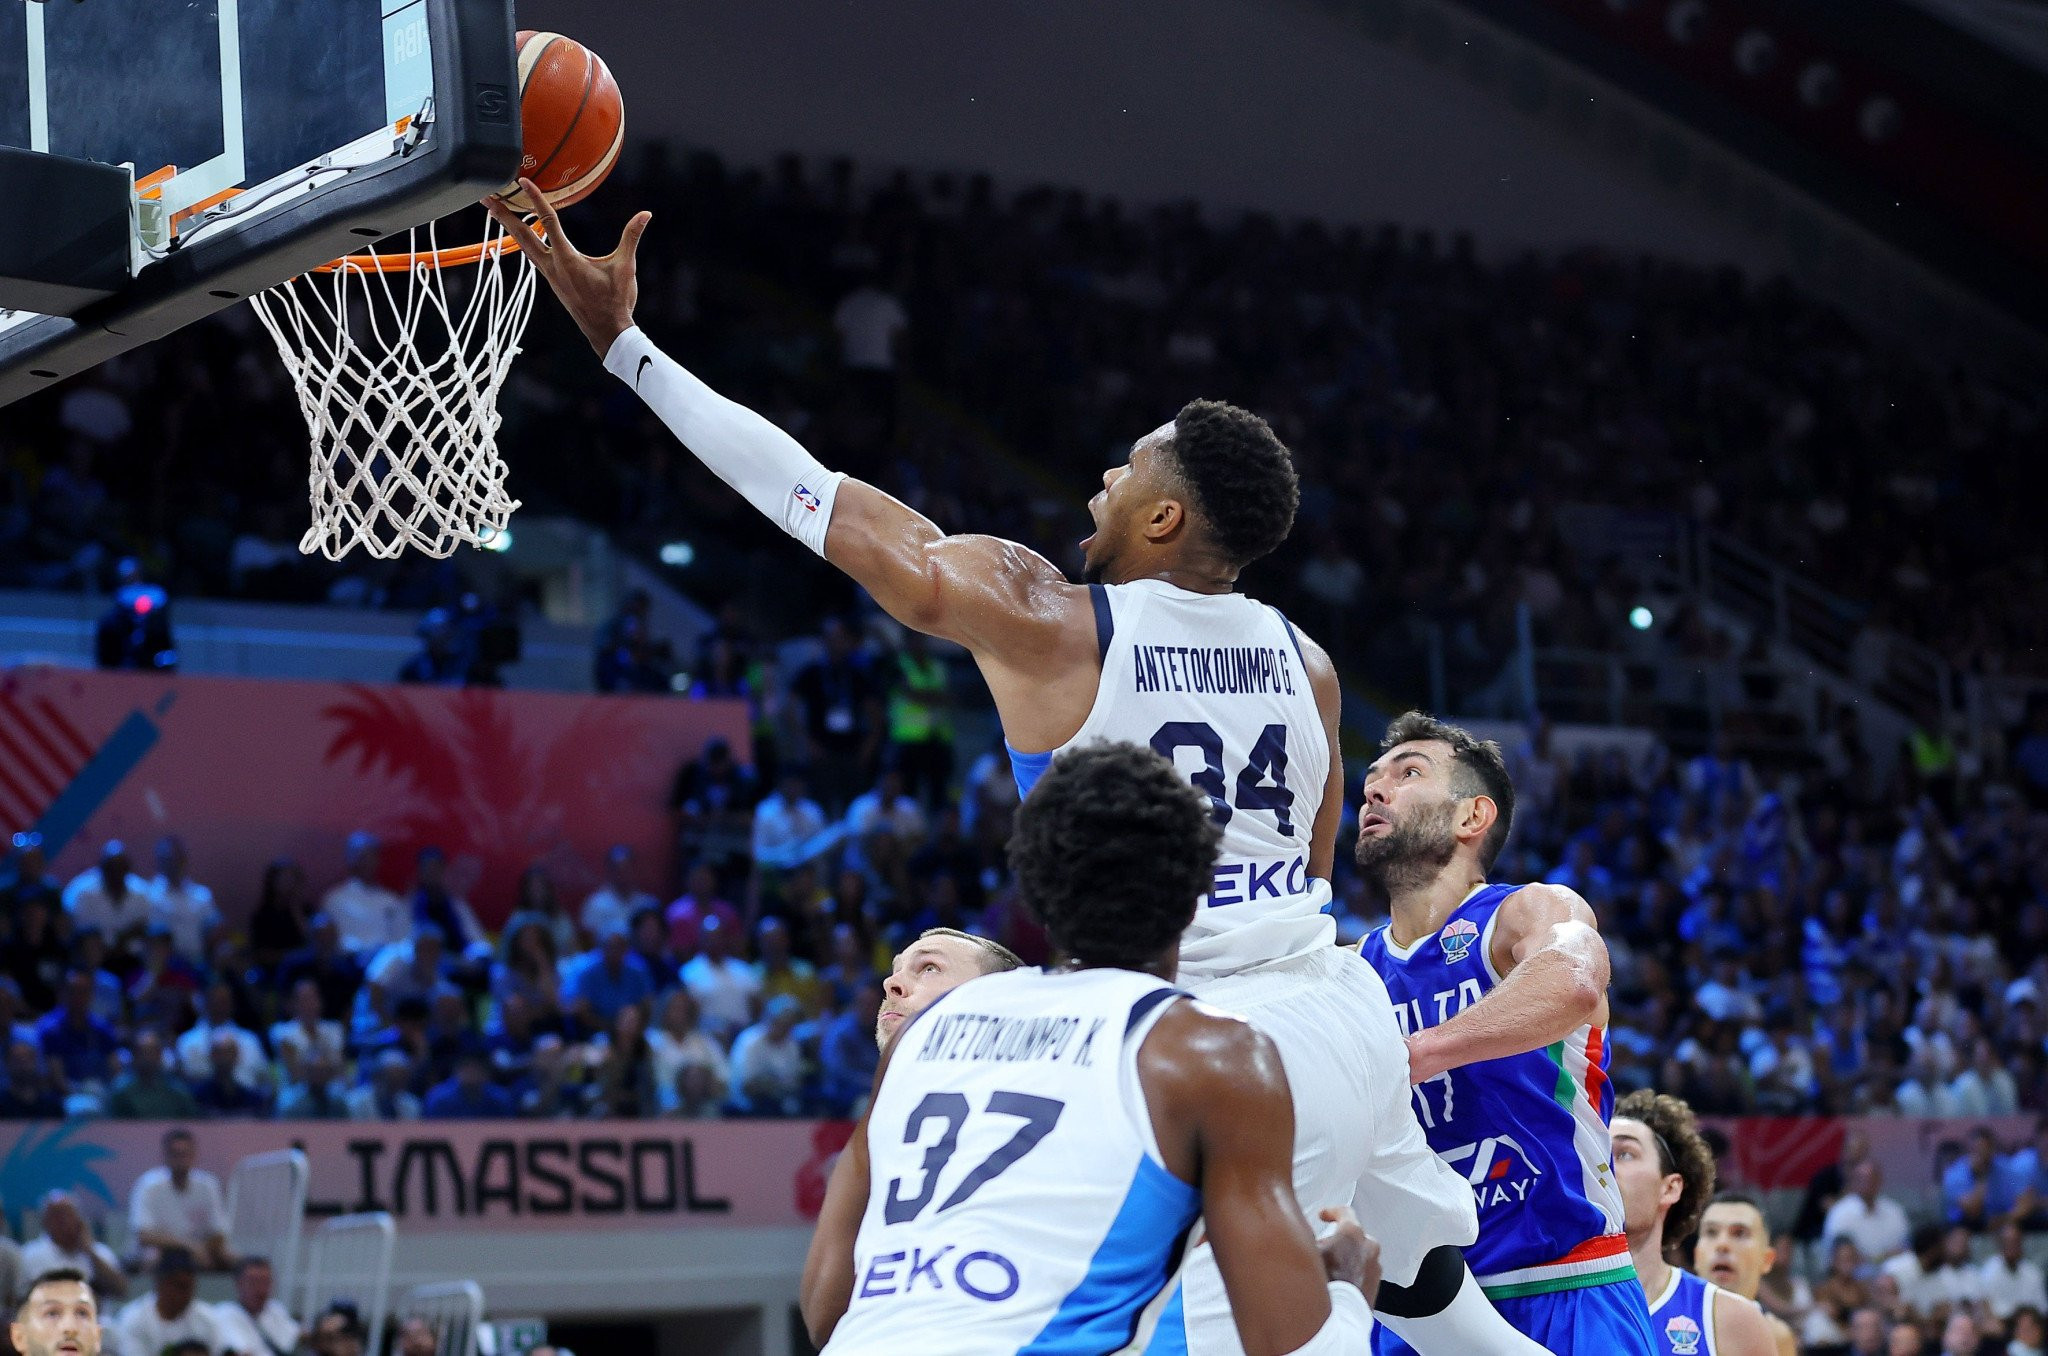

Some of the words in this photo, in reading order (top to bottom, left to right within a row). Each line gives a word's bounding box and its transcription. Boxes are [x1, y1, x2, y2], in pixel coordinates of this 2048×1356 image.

[1133, 644, 1281, 694] ANTETOKOUNMPO
[1279, 648, 1296, 696] G.
[1149, 721, 1295, 837] 34
[1207, 855, 1308, 908] EKO
[884, 1090, 1066, 1226] 37
[860, 1245, 1020, 1302] EKO
